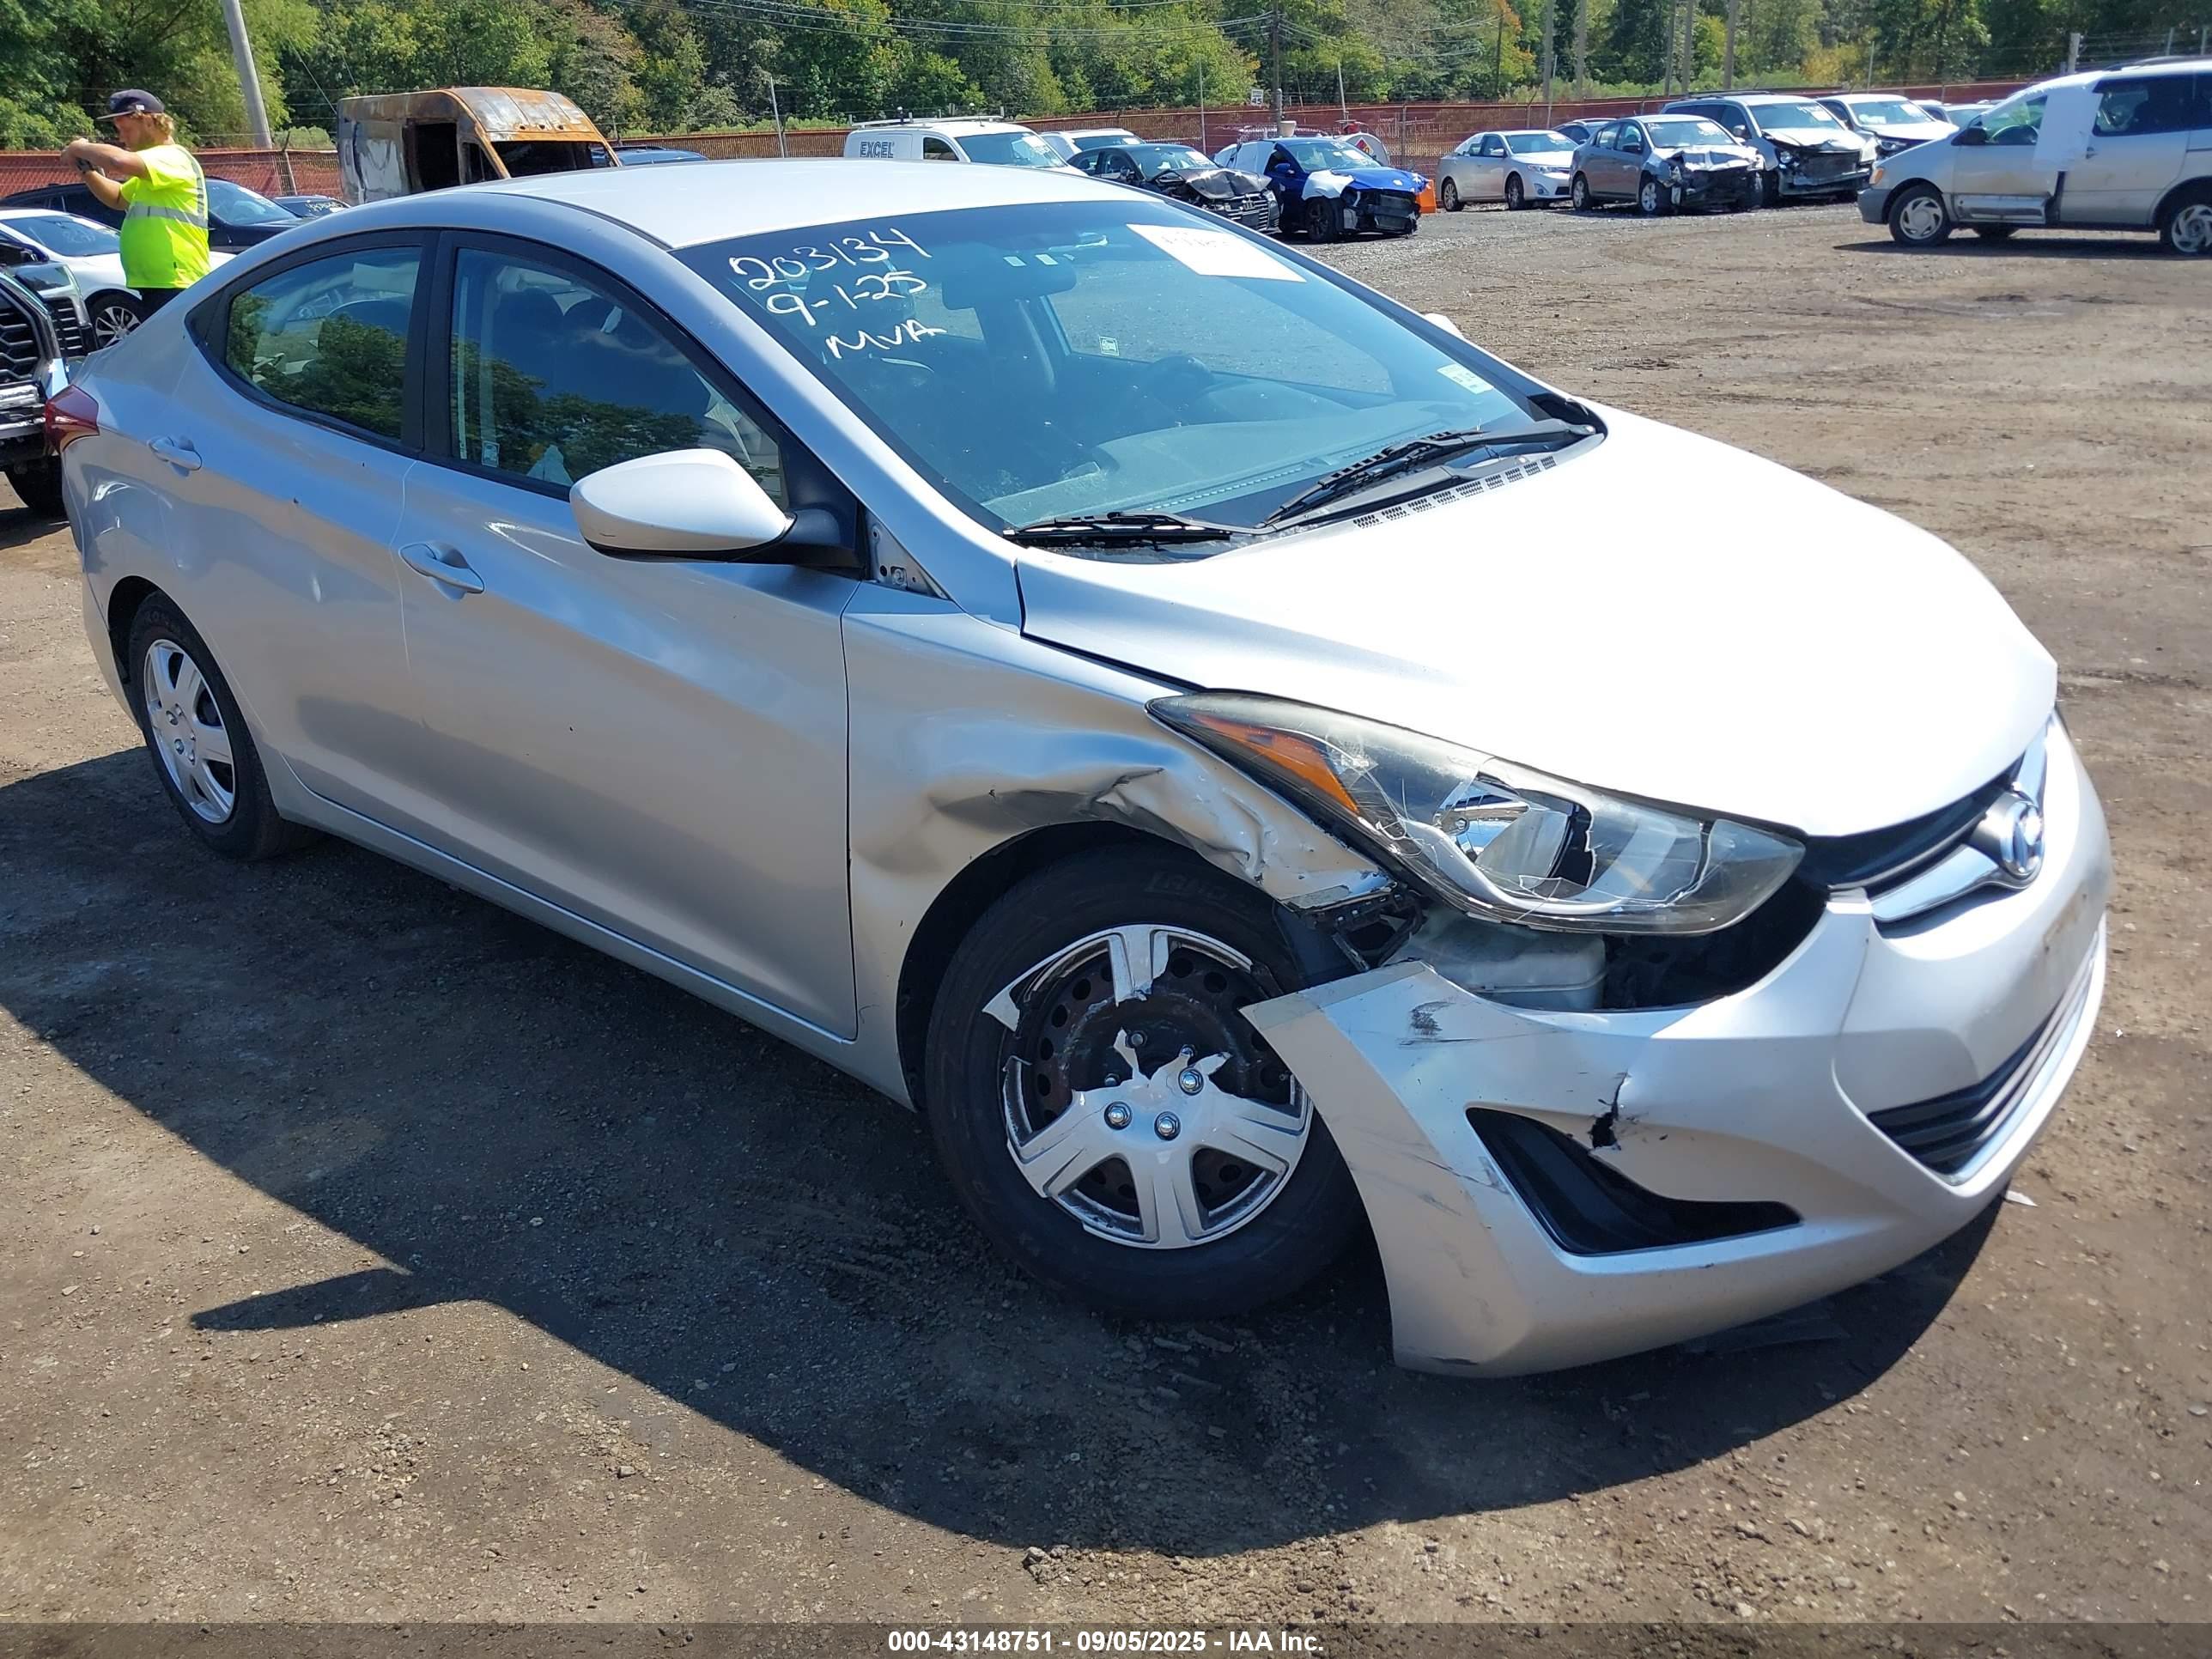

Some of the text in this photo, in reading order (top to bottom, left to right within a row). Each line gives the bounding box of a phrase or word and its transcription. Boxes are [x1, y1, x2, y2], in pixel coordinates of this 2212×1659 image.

[860, 141, 894, 159] EXCEL
[728, 228, 933, 291] 203134
[766, 270, 927, 326] 9-1-25
[825, 319, 948, 360] MVA
